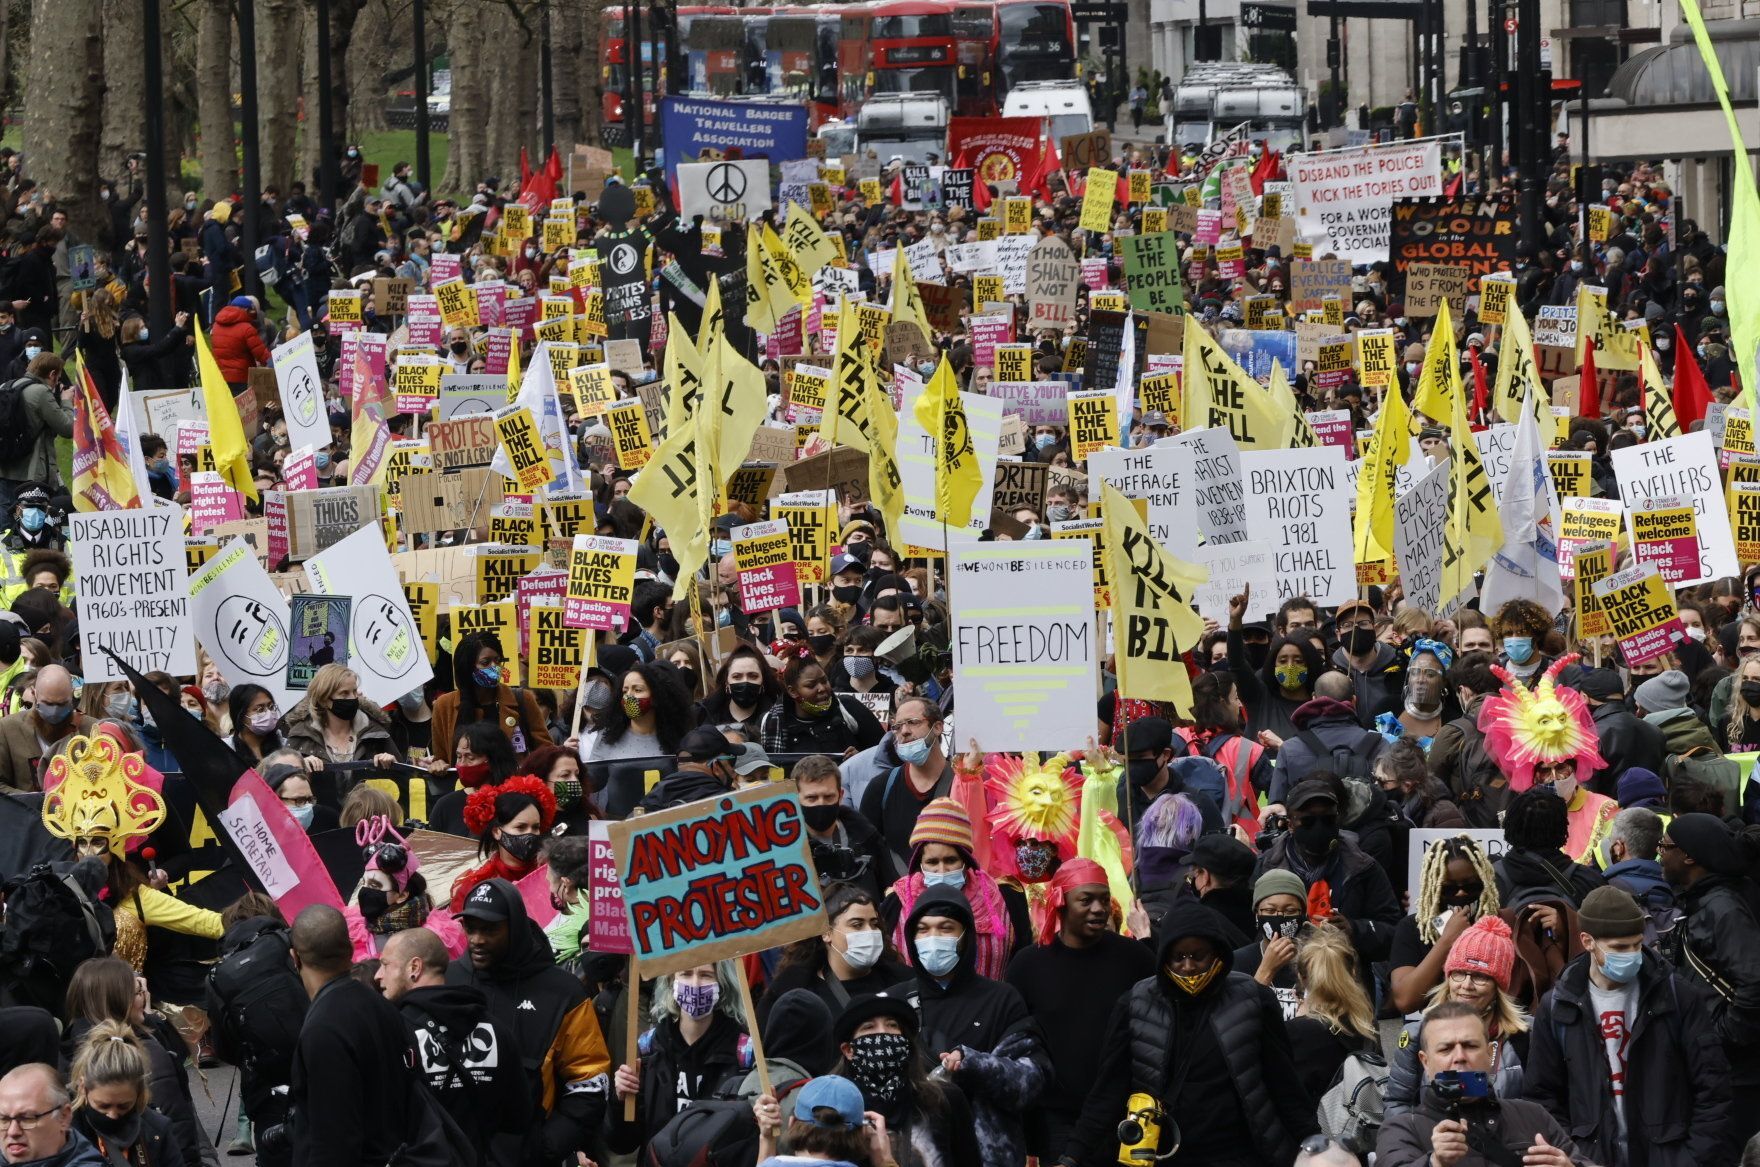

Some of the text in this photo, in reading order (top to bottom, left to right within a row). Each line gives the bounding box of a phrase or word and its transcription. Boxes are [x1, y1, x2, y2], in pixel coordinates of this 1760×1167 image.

[1048, 42, 1060, 52] 36
[695, 118, 772, 134] TRAVELLERS
[693, 131, 775, 148] ASSOCIATION
[1065, 135, 1109, 165] ACAB
[906, 167, 928, 178] KILL
[1299, 166, 1350, 182] DISBAND
[1353, 162, 1373, 175] THE
[1379, 156, 1424, 173] POLICE!
[944, 171, 972, 185] KILL
[945, 186, 970, 198] THE
[1312, 175, 1436, 203] KICK THE TORIES OUT!
[1008, 200, 1028, 210] KILL
[1396, 203, 1498, 221] WOMEN
[507, 208, 525, 218] KILL
[1008, 209, 1026, 218] THE
[1145, 211, 1163, 219] KILL
[1321, 210, 1355, 225] FOR A
[1008, 217, 1028, 225] BILL
[1395, 219, 1512, 237] COLOUR
[1032, 246, 1070, 260] THOU
[1135, 238, 1163, 253] LET
[1332, 241, 1340, 251] &
[1401, 242, 1499, 258] GLOBAL
[1136, 251, 1166, 268] THE
[1032, 263, 1078, 284] SHALT
[1302, 262, 1346, 274] POLICE
[1409, 267, 1468, 278] WHO PROTECTS
[977, 279, 999, 287] KILL
[1127, 267, 1179, 288] PEOPLE
[438, 283, 461, 298] KILL
[1035, 282, 1068, 297] NOT
[1411, 280, 1463, 291] US FROM
[1486, 283, 1510, 294] KILL
[330, 297, 353, 306] BLACK
[441, 293, 463, 307] THE
[1149, 290, 1166, 305] BE
[1408, 296, 1425, 307] THE
[1485, 293, 1507, 303] THE
[330, 305, 351, 313] LIVES
[442, 302, 467, 315] BILL
[1035, 302, 1068, 322] BILL
[1541, 306, 1577, 318] PRITI
[330, 312, 359, 321] MATTER
[1537, 319, 1558, 330] YOUR
[974, 333, 989, 341] right
[1362, 338, 1389, 349] KILL
[1537, 334, 1559, 344] WOMEN
[999, 351, 1026, 361] KILL
[1320, 345, 1339, 355] BLACK
[1363, 350, 1386, 360] THE
[999, 361, 1022, 371] THE
[1319, 354, 1340, 363] LIVES
[1319, 360, 1350, 371] MATTER
[398, 366, 429, 376] BLACK
[1364, 361, 1391, 372] BILL
[398, 375, 424, 385] LIVES
[575, 372, 604, 388] KILL
[795, 376, 825, 388] BLACK
[999, 371, 1026, 382] BILL
[398, 384, 436, 395] MATTER
[577, 384, 603, 397] THE
[793, 384, 819, 396] LIVES
[989, 385, 1066, 399] ACTIVE YOUTH
[1207, 376, 1244, 409] THE
[580, 392, 612, 405] BILL
[1048, 408, 1067, 423] ALL
[1074, 401, 1111, 416] KILL
[612, 408, 640, 425] KILL
[1075, 414, 1106, 429] THE
[1727, 417, 1751, 431] BLACK
[499, 415, 531, 439] KILL
[615, 423, 639, 438] THE
[1076, 427, 1113, 442] BILL
[1725, 428, 1746, 440] LIVES
[505, 432, 533, 454] THE
[619, 435, 647, 453] BILL
[1724, 438, 1755, 452] MATTER
[433, 453, 443, 468] IS
[512, 448, 544, 471] BILL
[1124, 455, 1153, 470] THE
[1641, 445, 1676, 468] THE
[1251, 466, 1335, 495] BRIXTON
[994, 491, 1040, 507] PLEASE
[1268, 494, 1324, 519] RIOTS
[1398, 473, 1444, 525] BLACK
[313, 501, 359, 524] THUGS
[1564, 512, 1617, 528] Refugees
[1635, 512, 1692, 528] Refugees
[74, 515, 170, 541] DISABILITY
[1404, 497, 1446, 546] LIVES
[1282, 521, 1319, 546] 1981
[1563, 526, 1613, 540] welcome
[1636, 526, 1690, 542] welcome
[93, 541, 163, 568] RIGHTS
[736, 539, 787, 556] Refugees
[573, 551, 620, 570] BLACK
[738, 551, 787, 569] welcome
[956, 560, 1087, 574] #WEWONTBESILENCED
[81, 569, 176, 596] MOVEMENT
[571, 567, 612, 584] LIVES
[740, 568, 775, 585] Black
[569, 581, 630, 602] MATTER
[743, 583, 775, 597] Lives
[1604, 582, 1652, 610] BLACK
[567, 601, 612, 613] No justice
[744, 593, 785, 611] Matter
[566, 610, 606, 623] No peace
[1608, 598, 1650, 624] LIVES
[1614, 605, 1675, 641] MATTER
[87, 626, 177, 655] EQUALITY
[958, 622, 1089, 665] FREEDOM
[1622, 627, 1666, 649] No justice
[1626, 638, 1666, 658] No peace
[537, 649, 583, 666] BILL
[537, 679, 571, 687] POWERS
[861, 693, 890, 702] HUMAN
[252, 821, 277, 860] HOME
[625, 799, 801, 887] ANNOYING
[229, 817, 278, 891] SECRETARY
[631, 859, 820, 954] PROTESTER
[684, 985, 704, 997] ALL
